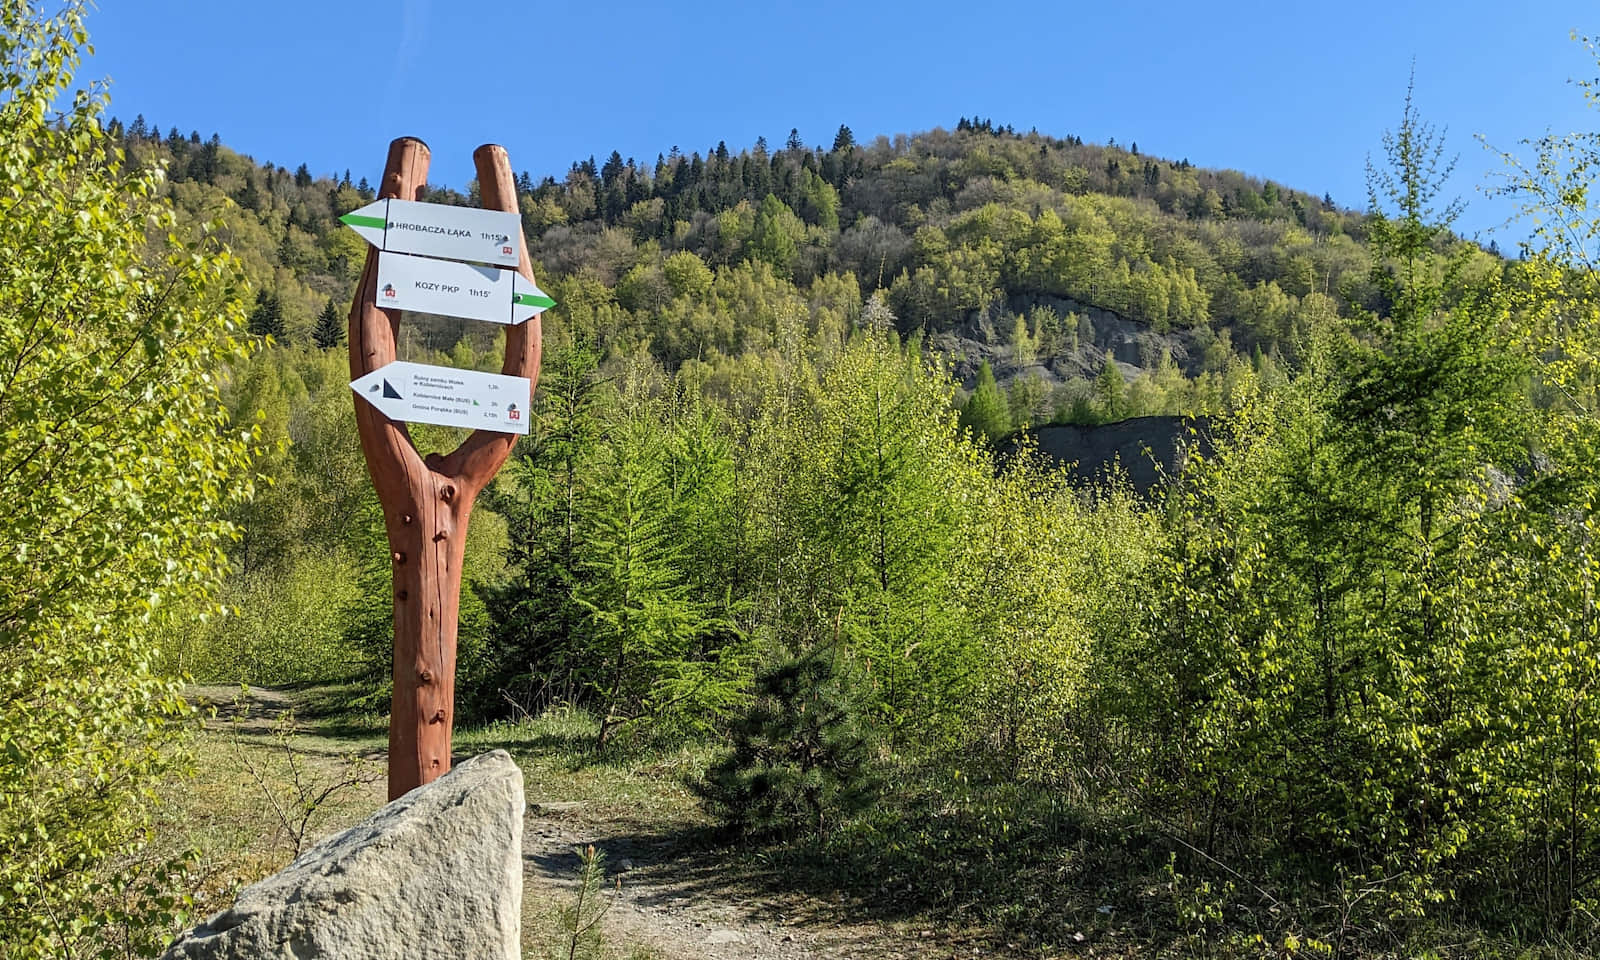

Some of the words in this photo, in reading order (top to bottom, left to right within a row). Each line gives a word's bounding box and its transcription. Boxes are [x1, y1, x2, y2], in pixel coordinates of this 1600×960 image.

[395, 222, 445, 234] HROBACZA
[447, 228, 472, 238] ŁĄKA
[415, 281, 440, 292] KOZY
[441, 284, 460, 294] PKP
